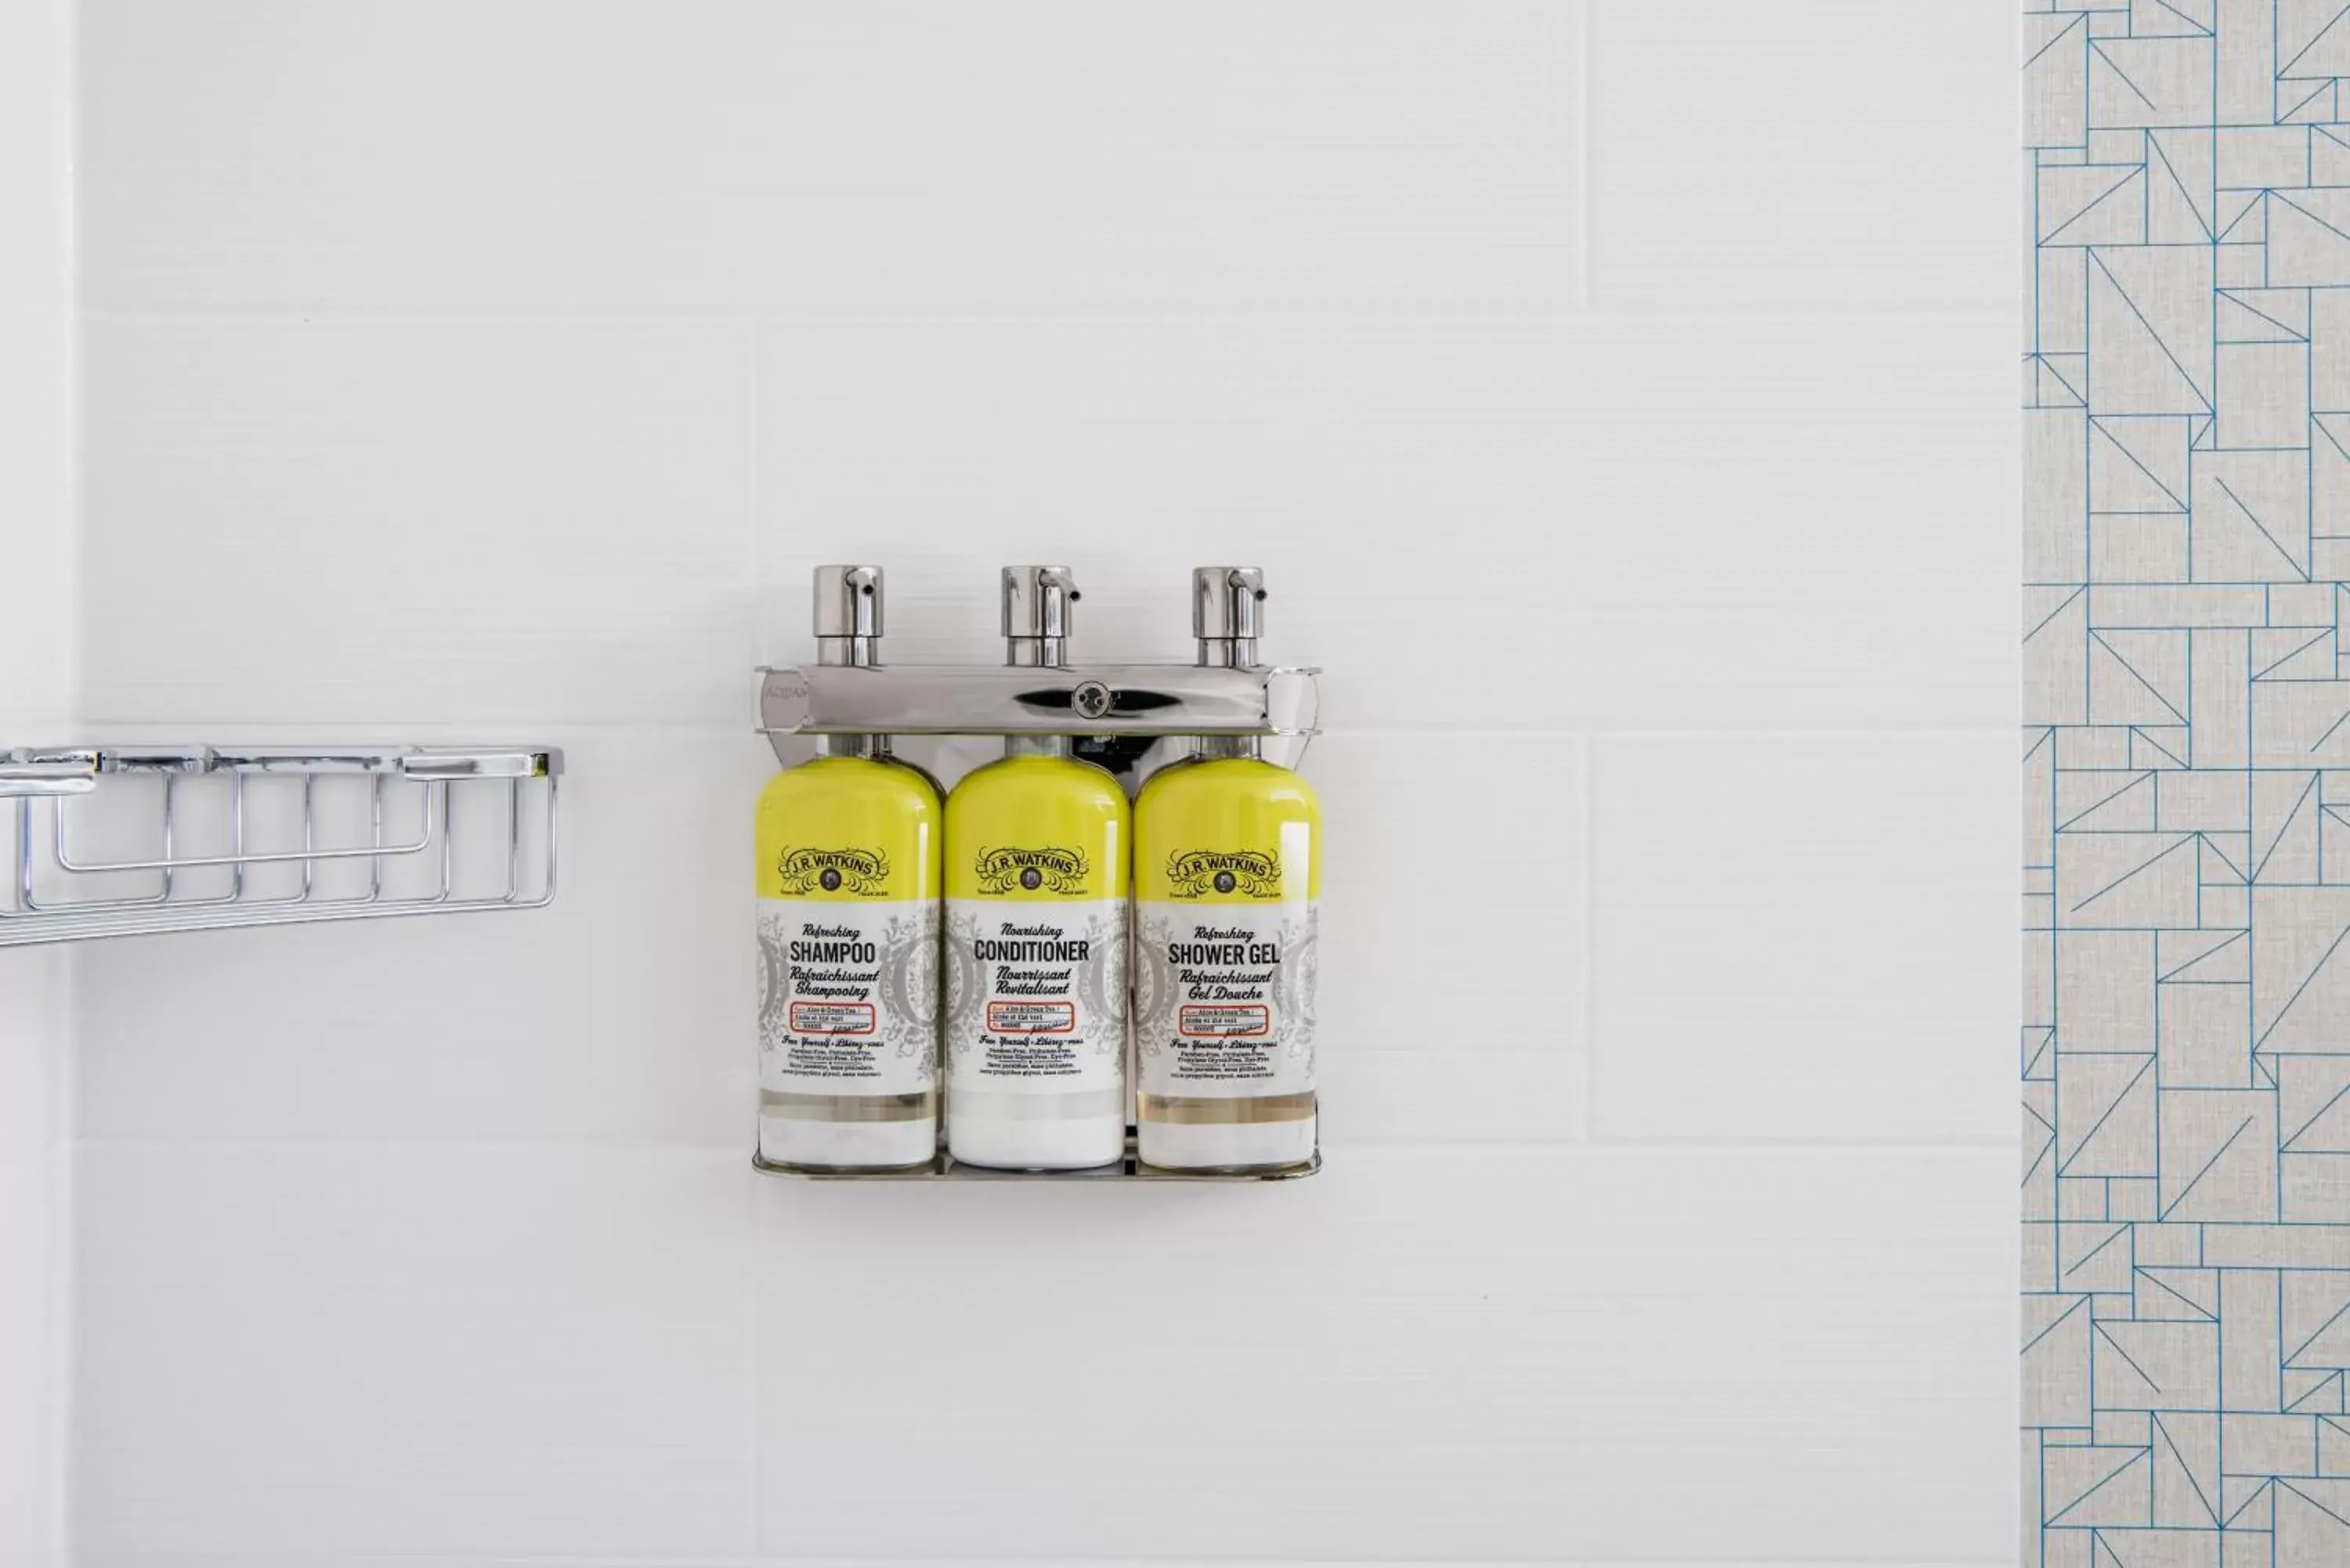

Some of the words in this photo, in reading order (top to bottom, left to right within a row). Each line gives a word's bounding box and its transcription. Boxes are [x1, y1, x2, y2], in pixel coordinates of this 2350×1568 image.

[813, 854, 873, 875] WATKINS
[1013, 853, 1073, 874] WATKINS
[1206, 856, 1267, 876] WATKINS
[802, 923, 861, 941] Refreshing
[1000, 923, 1064, 940] Nourishing
[1194, 926, 1255, 943] Refreshing
[790, 941, 876, 963] SHAMPOO
[974, 940, 1090, 962] CONDITIONER
[1168, 943, 1245, 965] SHOWER
[1249, 943, 1281, 965] GEL
[996, 965, 1072, 980] Nourrissant
[795, 981, 870, 1001] Shampooing
[995, 980, 1070, 995] Revitalisant
[1188, 985, 1213, 1000] Gel
[1213, 985, 1264, 1000] Douche
